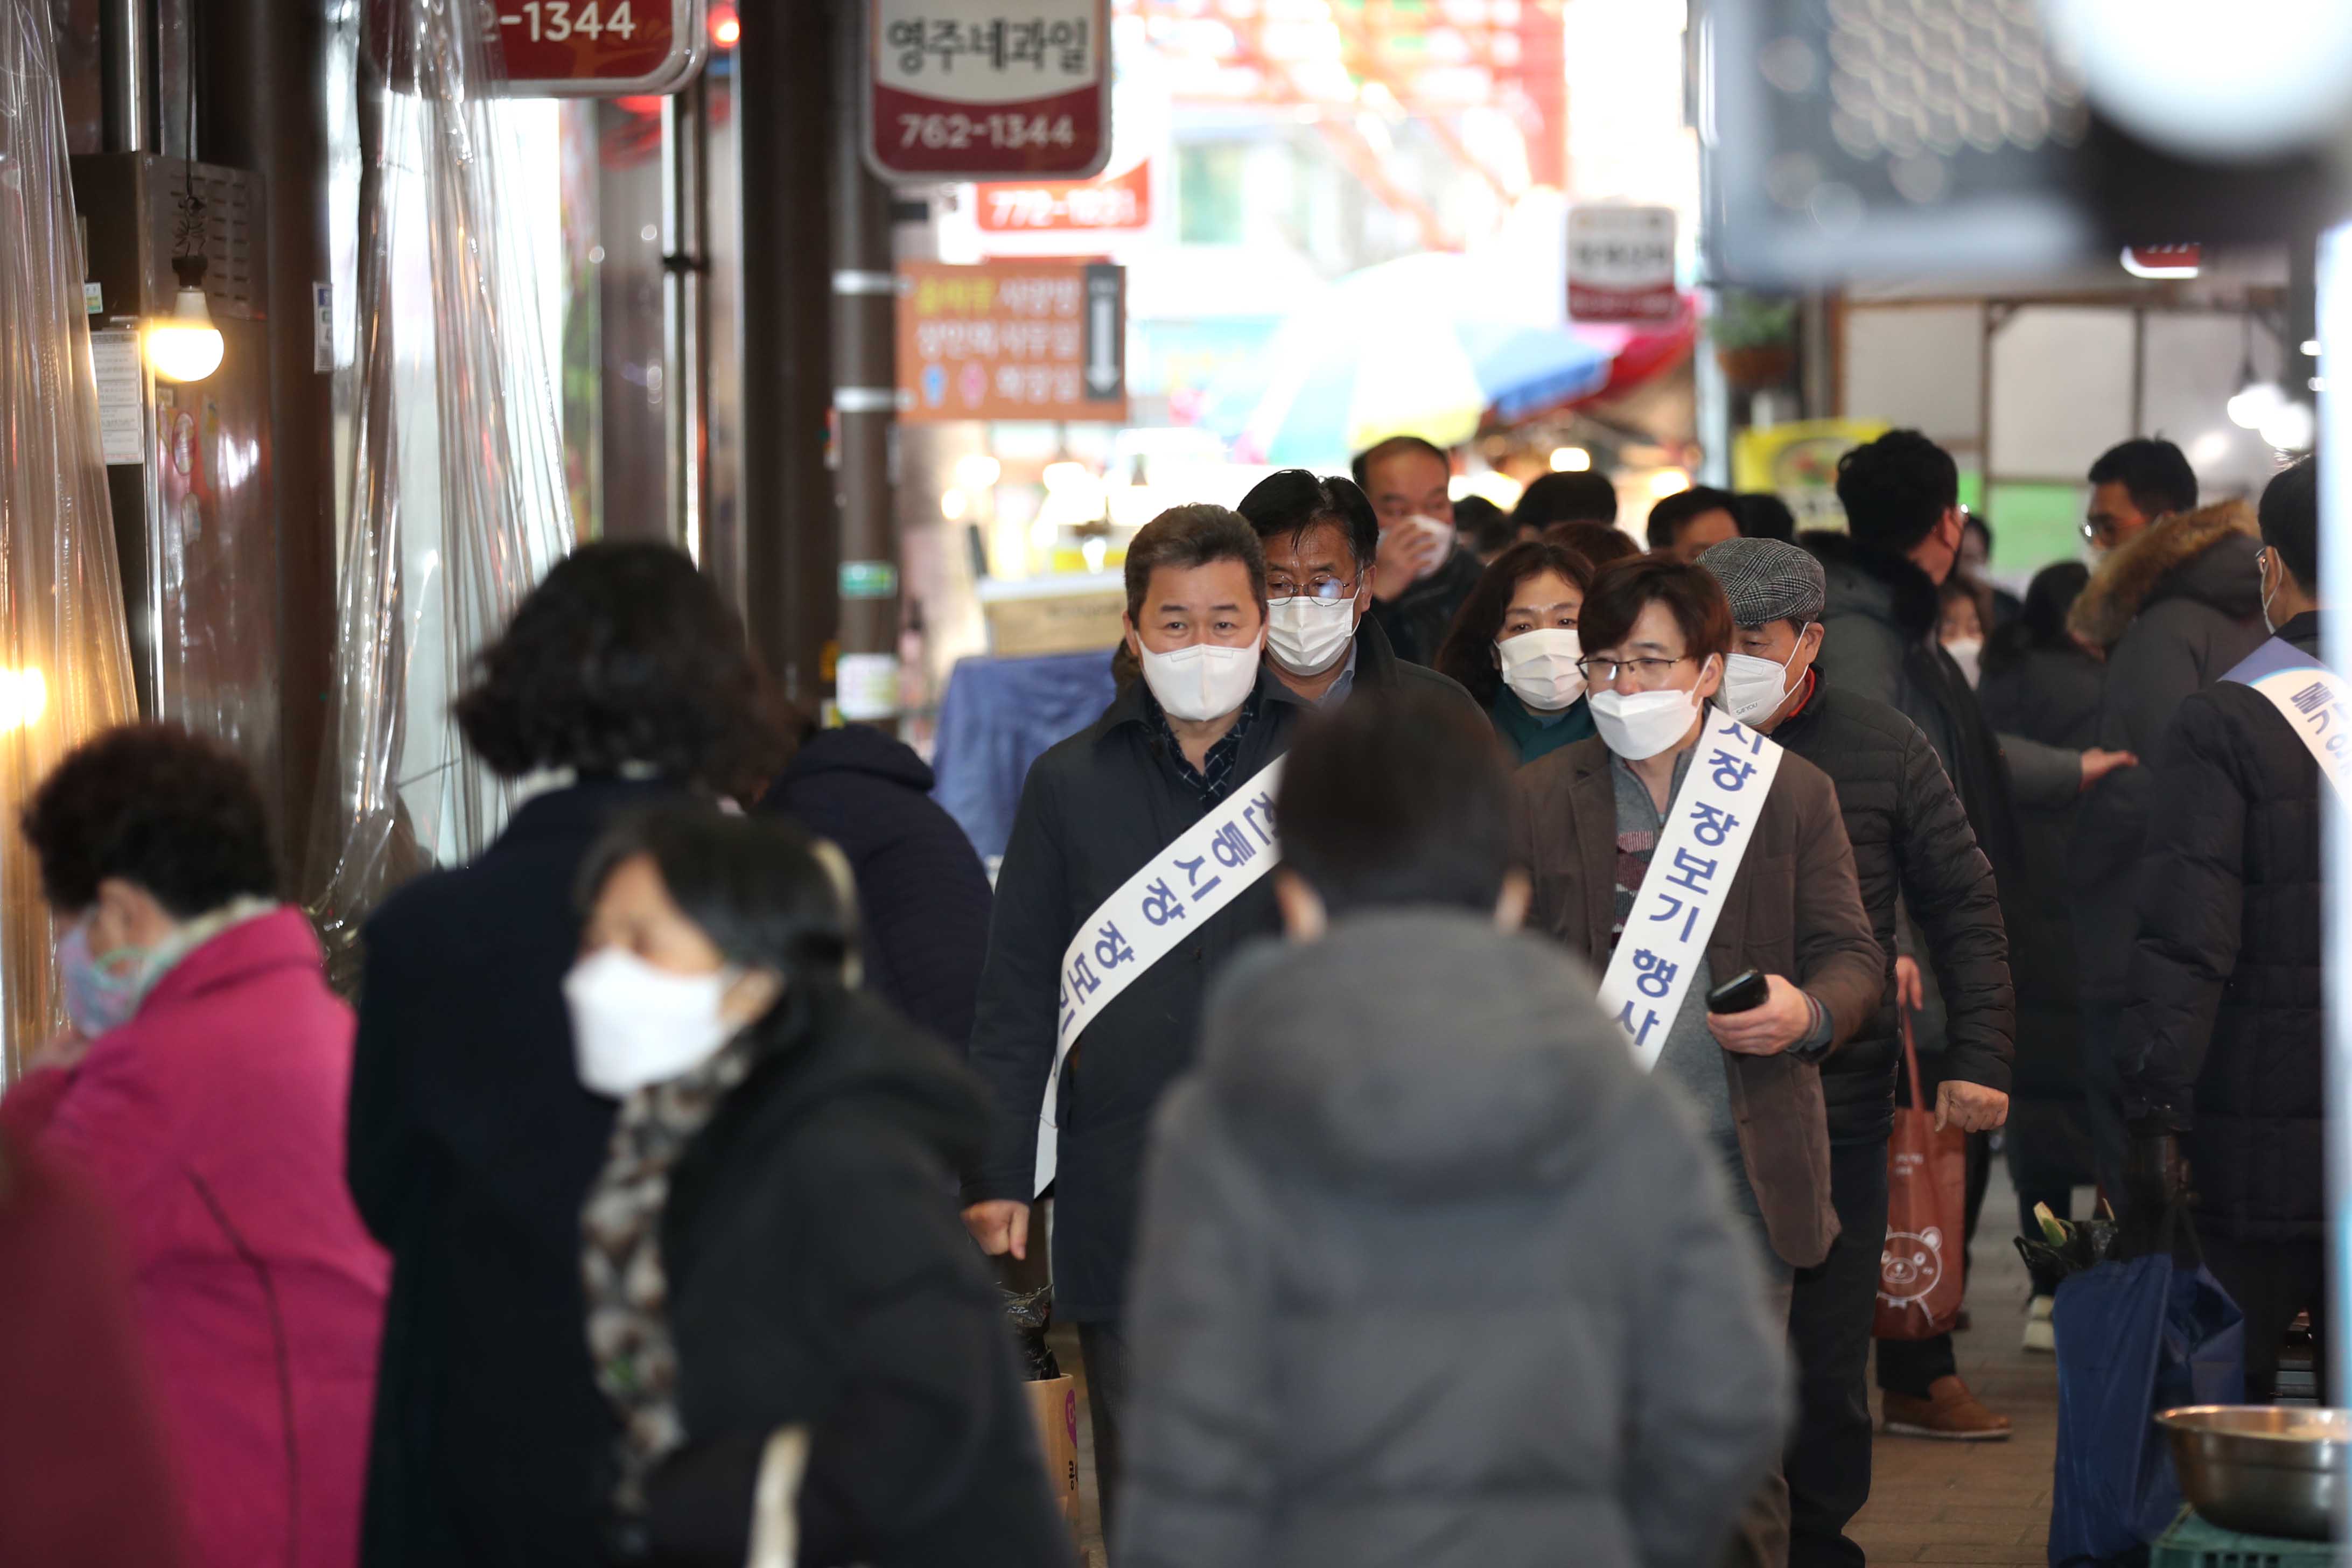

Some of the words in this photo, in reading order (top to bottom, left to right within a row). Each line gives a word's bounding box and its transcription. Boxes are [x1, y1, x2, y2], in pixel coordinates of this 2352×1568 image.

[480, 1, 637, 42] 2-1344
[888, 18, 1088, 74] 영주네과일
[898, 114, 1074, 148] 762-1344
[918, 319, 998, 360] 상인회
[1000, 319, 1079, 360] 사무실
[996, 365, 1079, 404] 화장실
[1709, 722, 1763, 792] 시장
[1649, 801, 1740, 943] 장보기
[1617, 949, 1679, 1046] 행사
